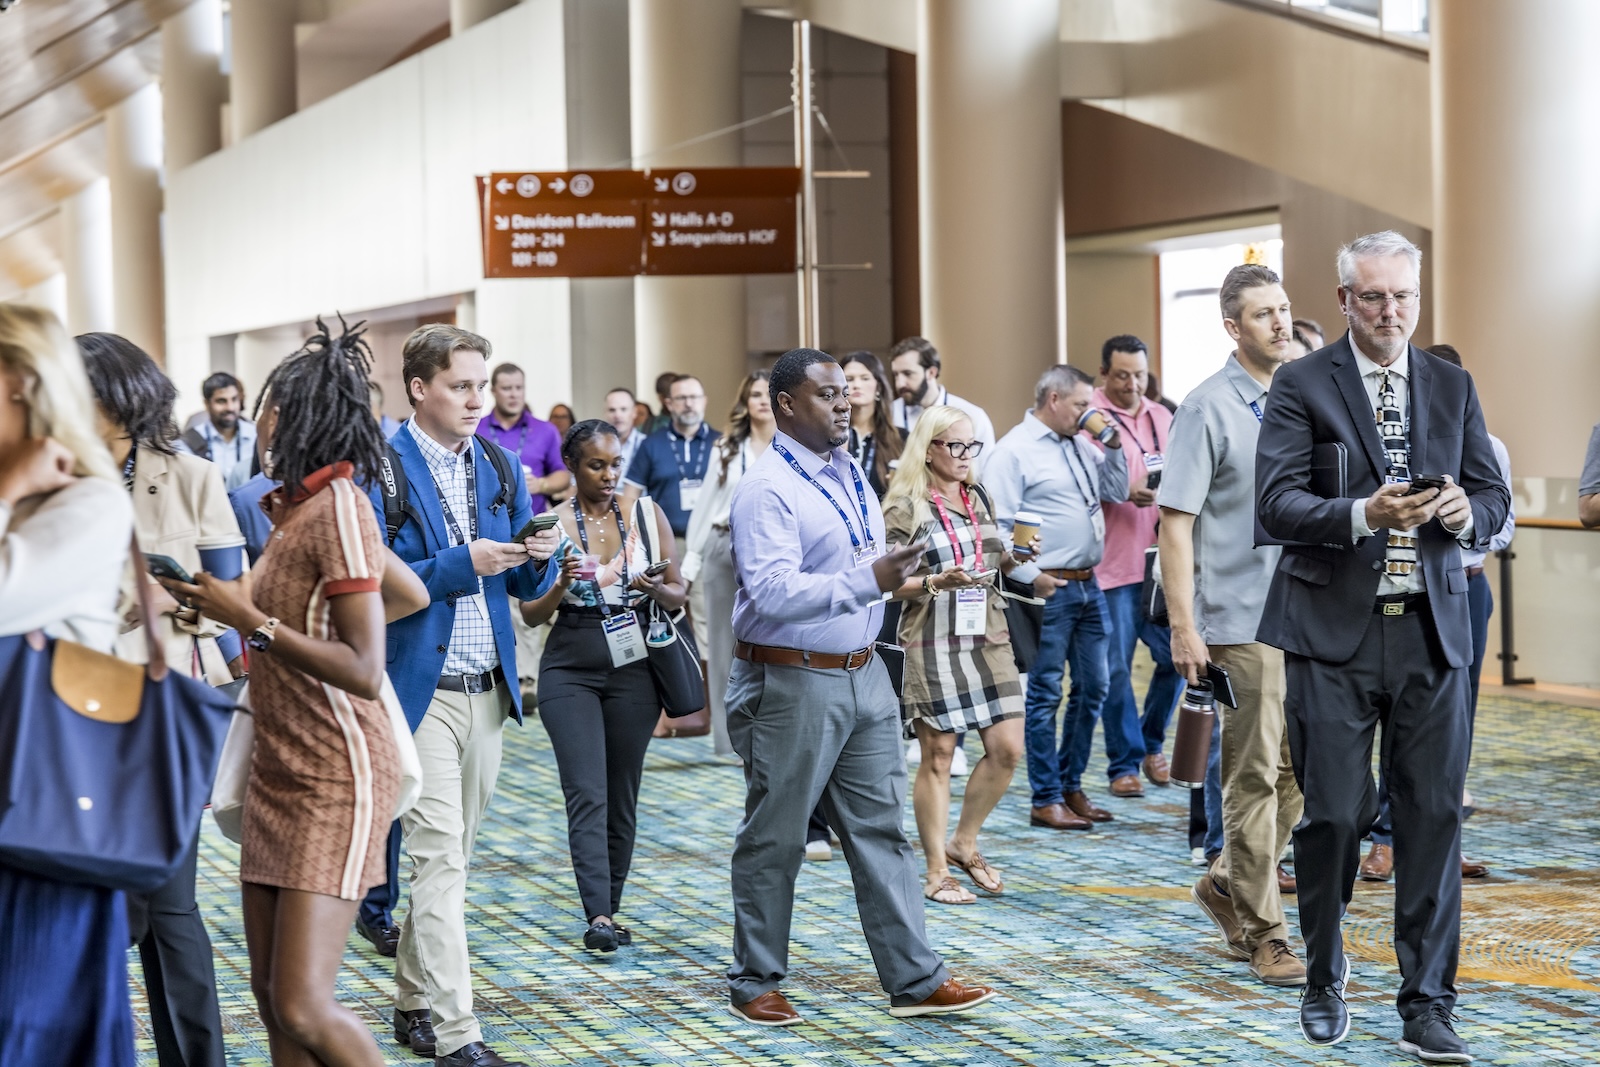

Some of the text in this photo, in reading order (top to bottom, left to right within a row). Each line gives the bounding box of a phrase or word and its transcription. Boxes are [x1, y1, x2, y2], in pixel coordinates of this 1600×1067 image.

[511, 213, 636, 229] Davidson Ballroom
[669, 211, 703, 227] Halls
[511, 232, 565, 248] 201-214
[669, 229, 777, 248] Songwriters HOF
